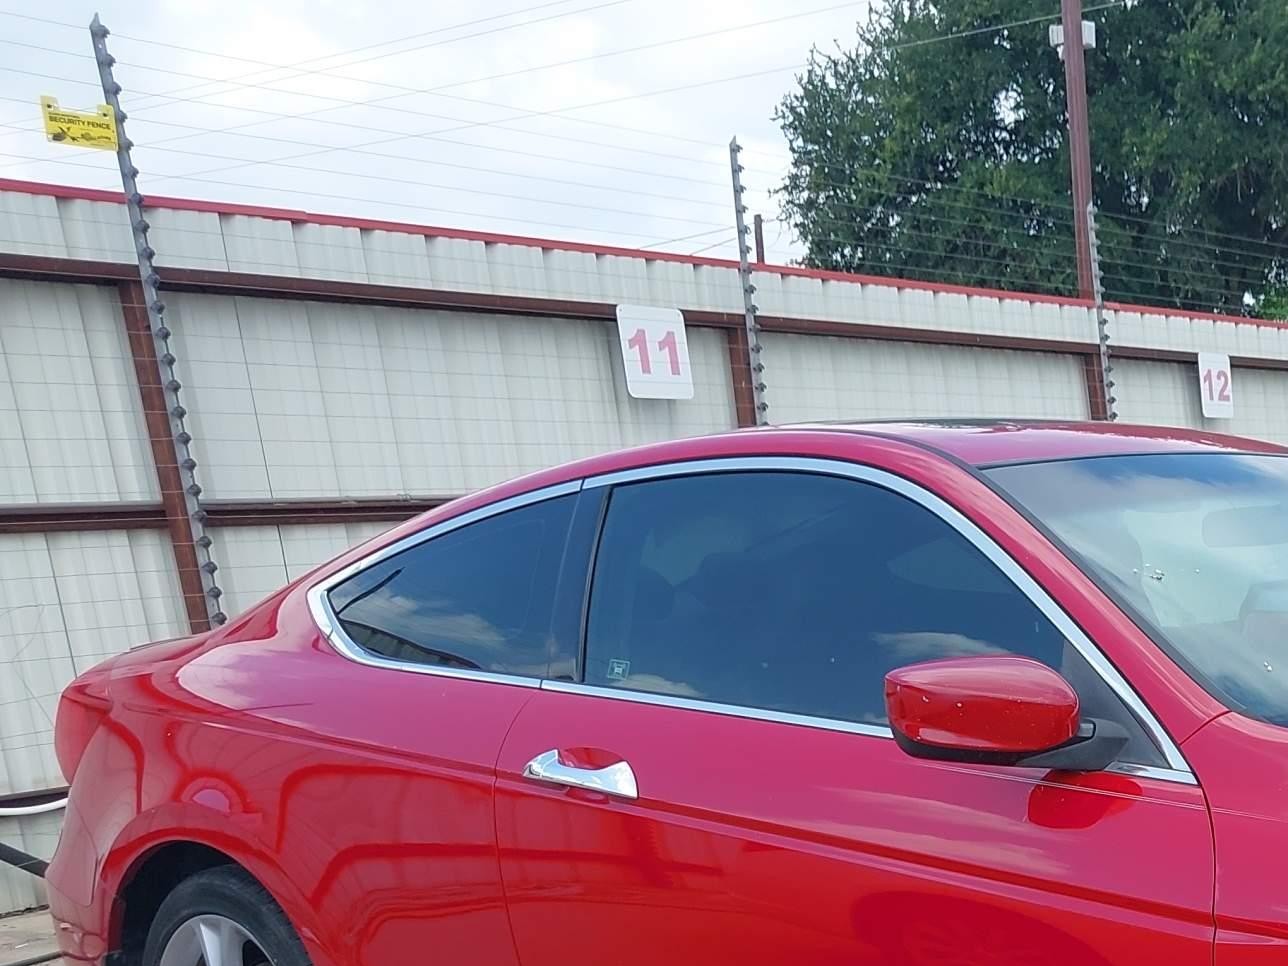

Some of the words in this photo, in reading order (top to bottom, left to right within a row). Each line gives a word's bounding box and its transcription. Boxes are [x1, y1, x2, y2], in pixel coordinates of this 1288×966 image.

[48, 115, 85, 127] SECURITY
[87, 120, 111, 130] FENCE
[627, 328, 681, 376] 11
[1203, 368, 1231, 402] 12
